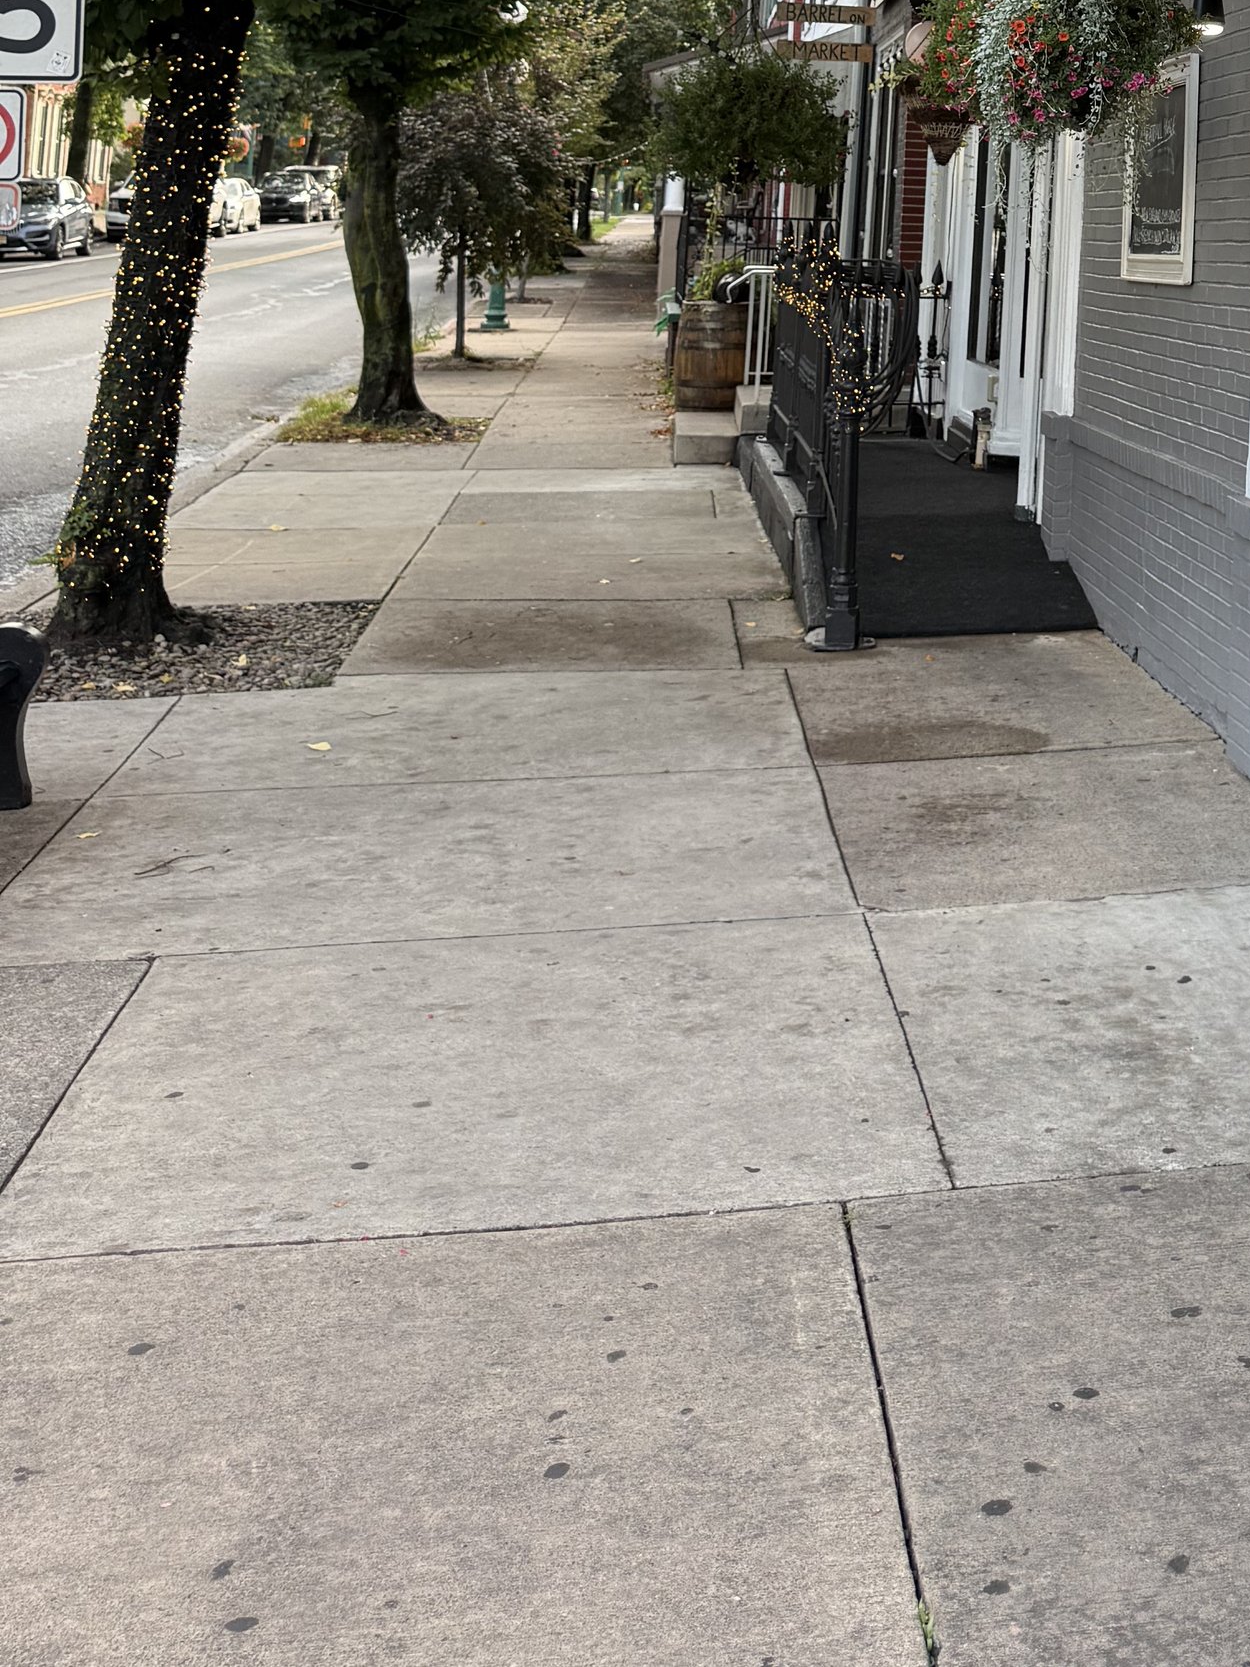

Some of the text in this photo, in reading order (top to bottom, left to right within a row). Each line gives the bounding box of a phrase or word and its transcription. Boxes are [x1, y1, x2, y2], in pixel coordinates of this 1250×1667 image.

[786, 2, 866, 24] BARREL ON
[792, 44, 862, 61] MARKET
